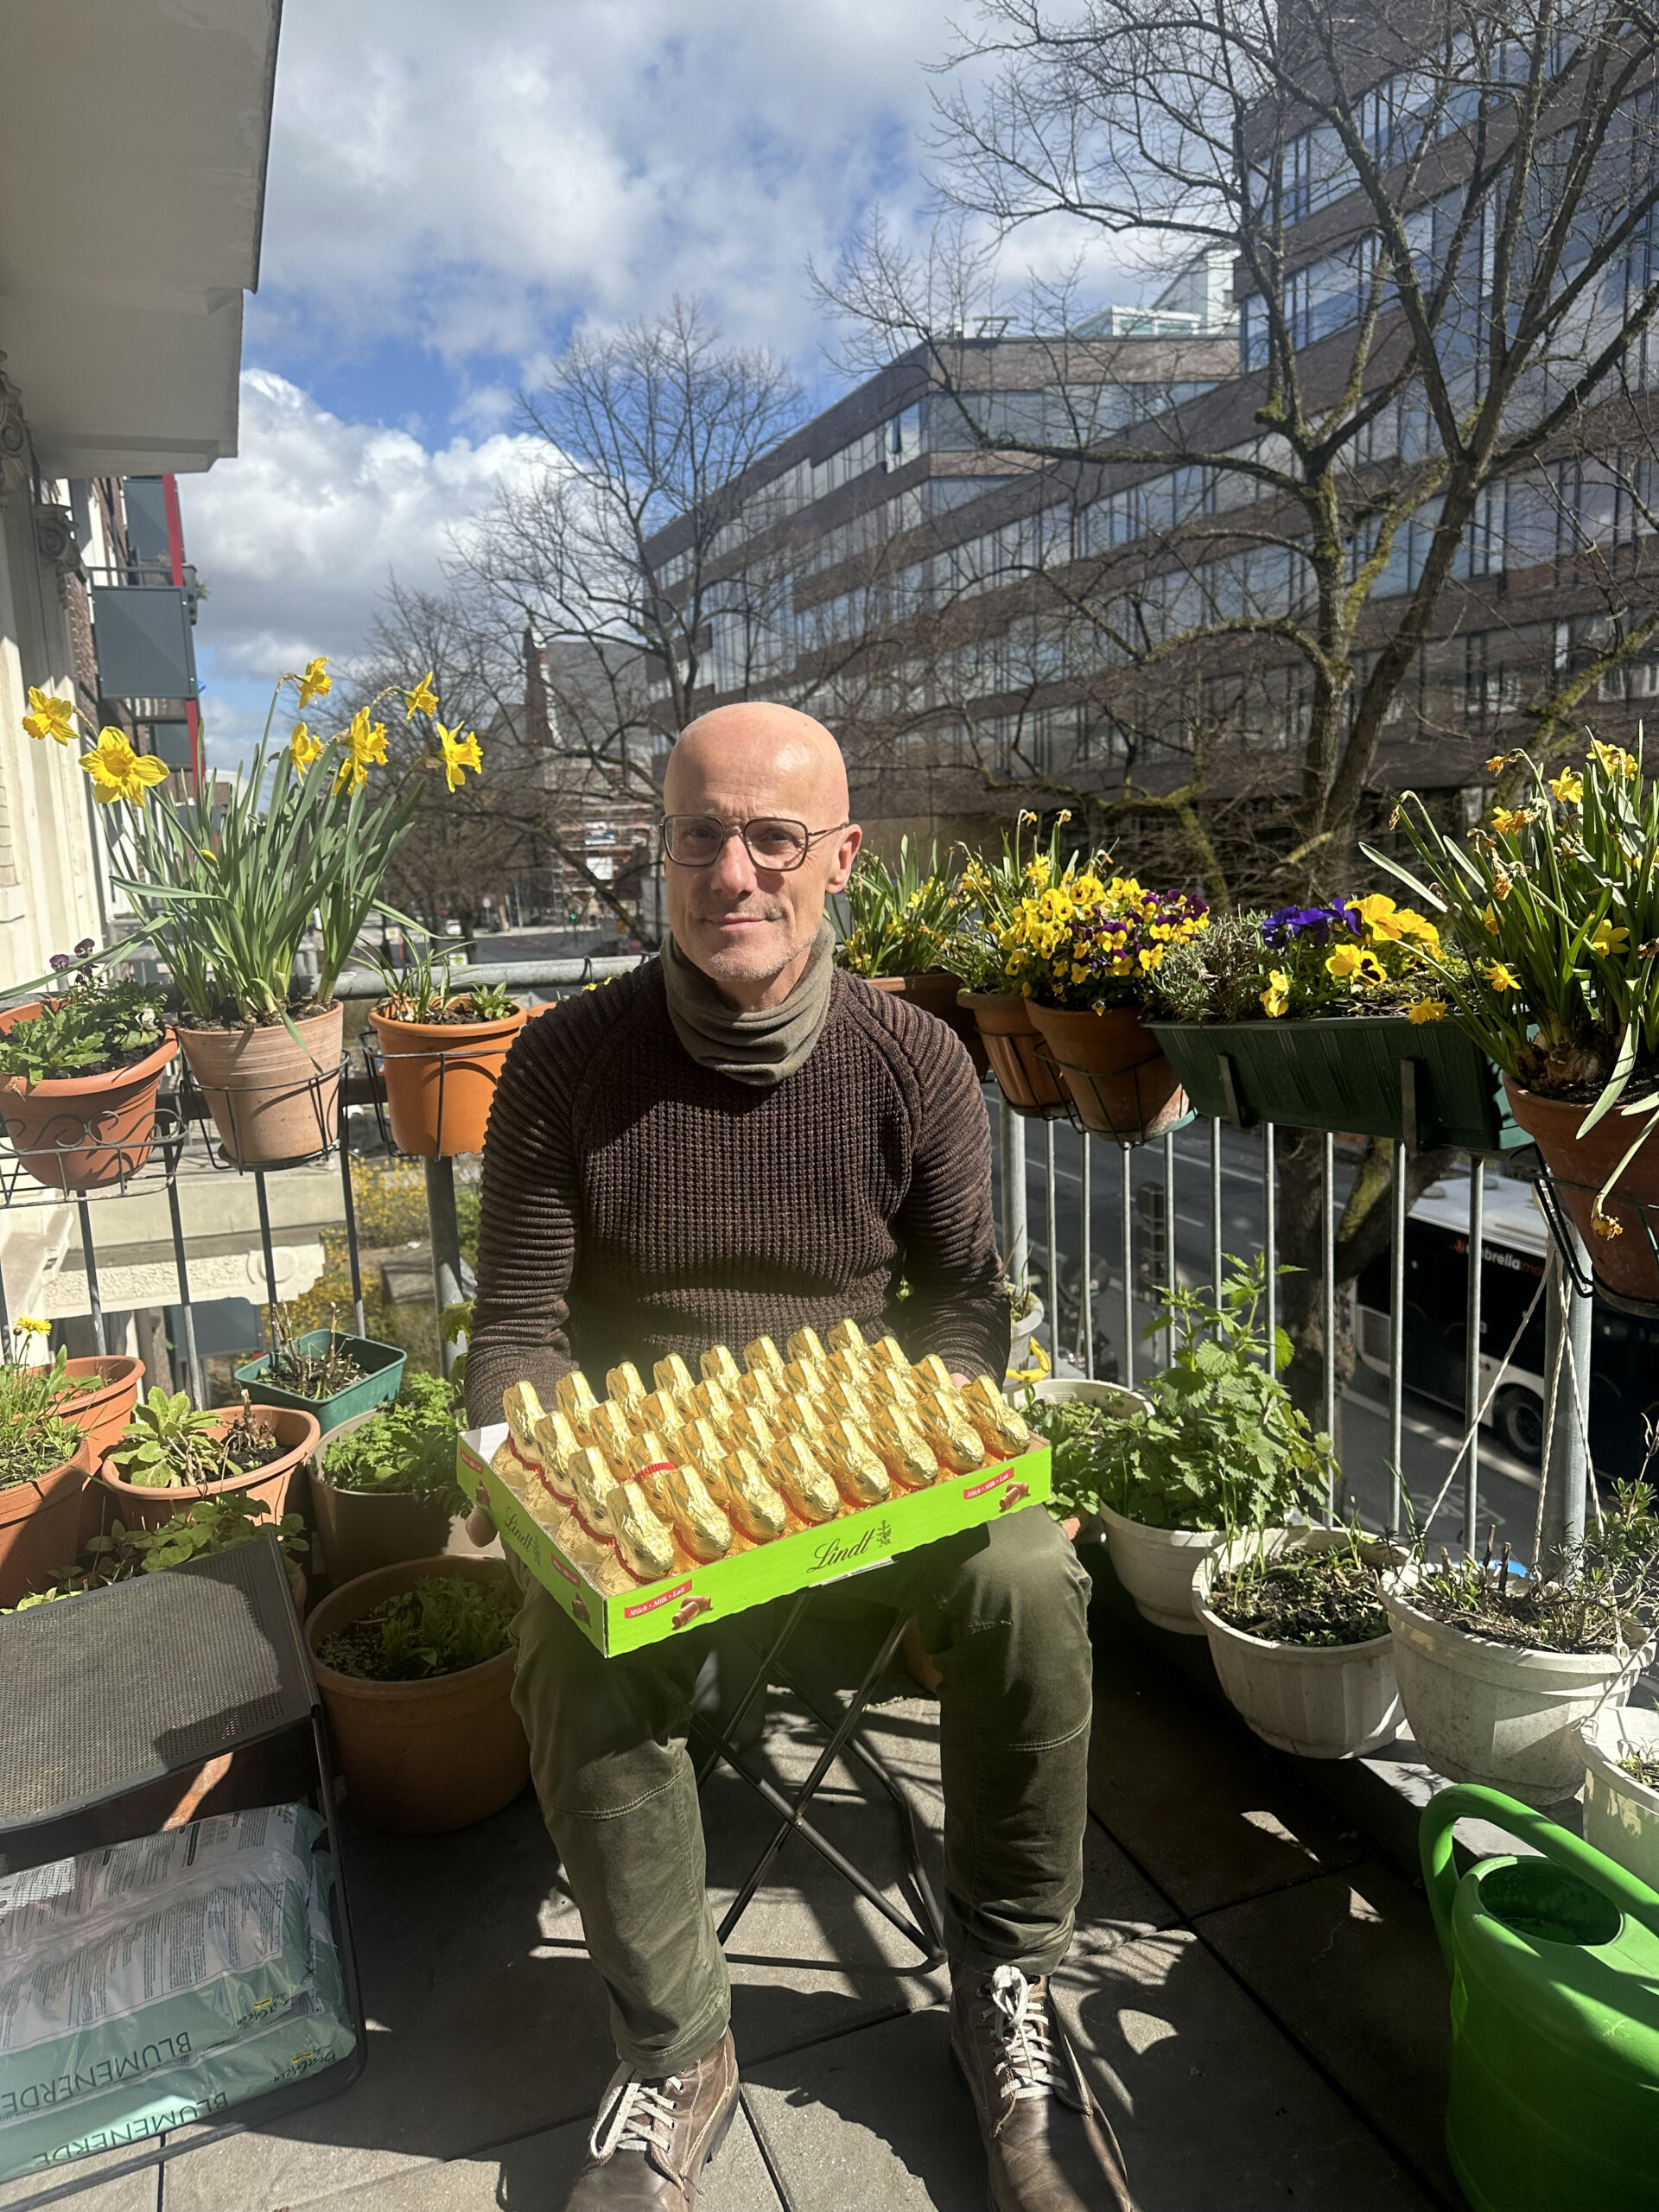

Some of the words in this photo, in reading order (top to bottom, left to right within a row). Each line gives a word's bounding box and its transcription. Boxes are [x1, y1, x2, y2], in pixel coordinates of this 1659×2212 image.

[503, 1506, 533, 1553] Lindt
[806, 1528, 876, 1573] Lindt
[628, 1605, 648, 1617] Milch
[652, 1596, 668, 1607] Milk
[672, 1586, 685, 1598] Lait
[1, 2031, 194, 2113] BLUMENERDE
[32, 2091, 230, 2166] BLUMENERDE
